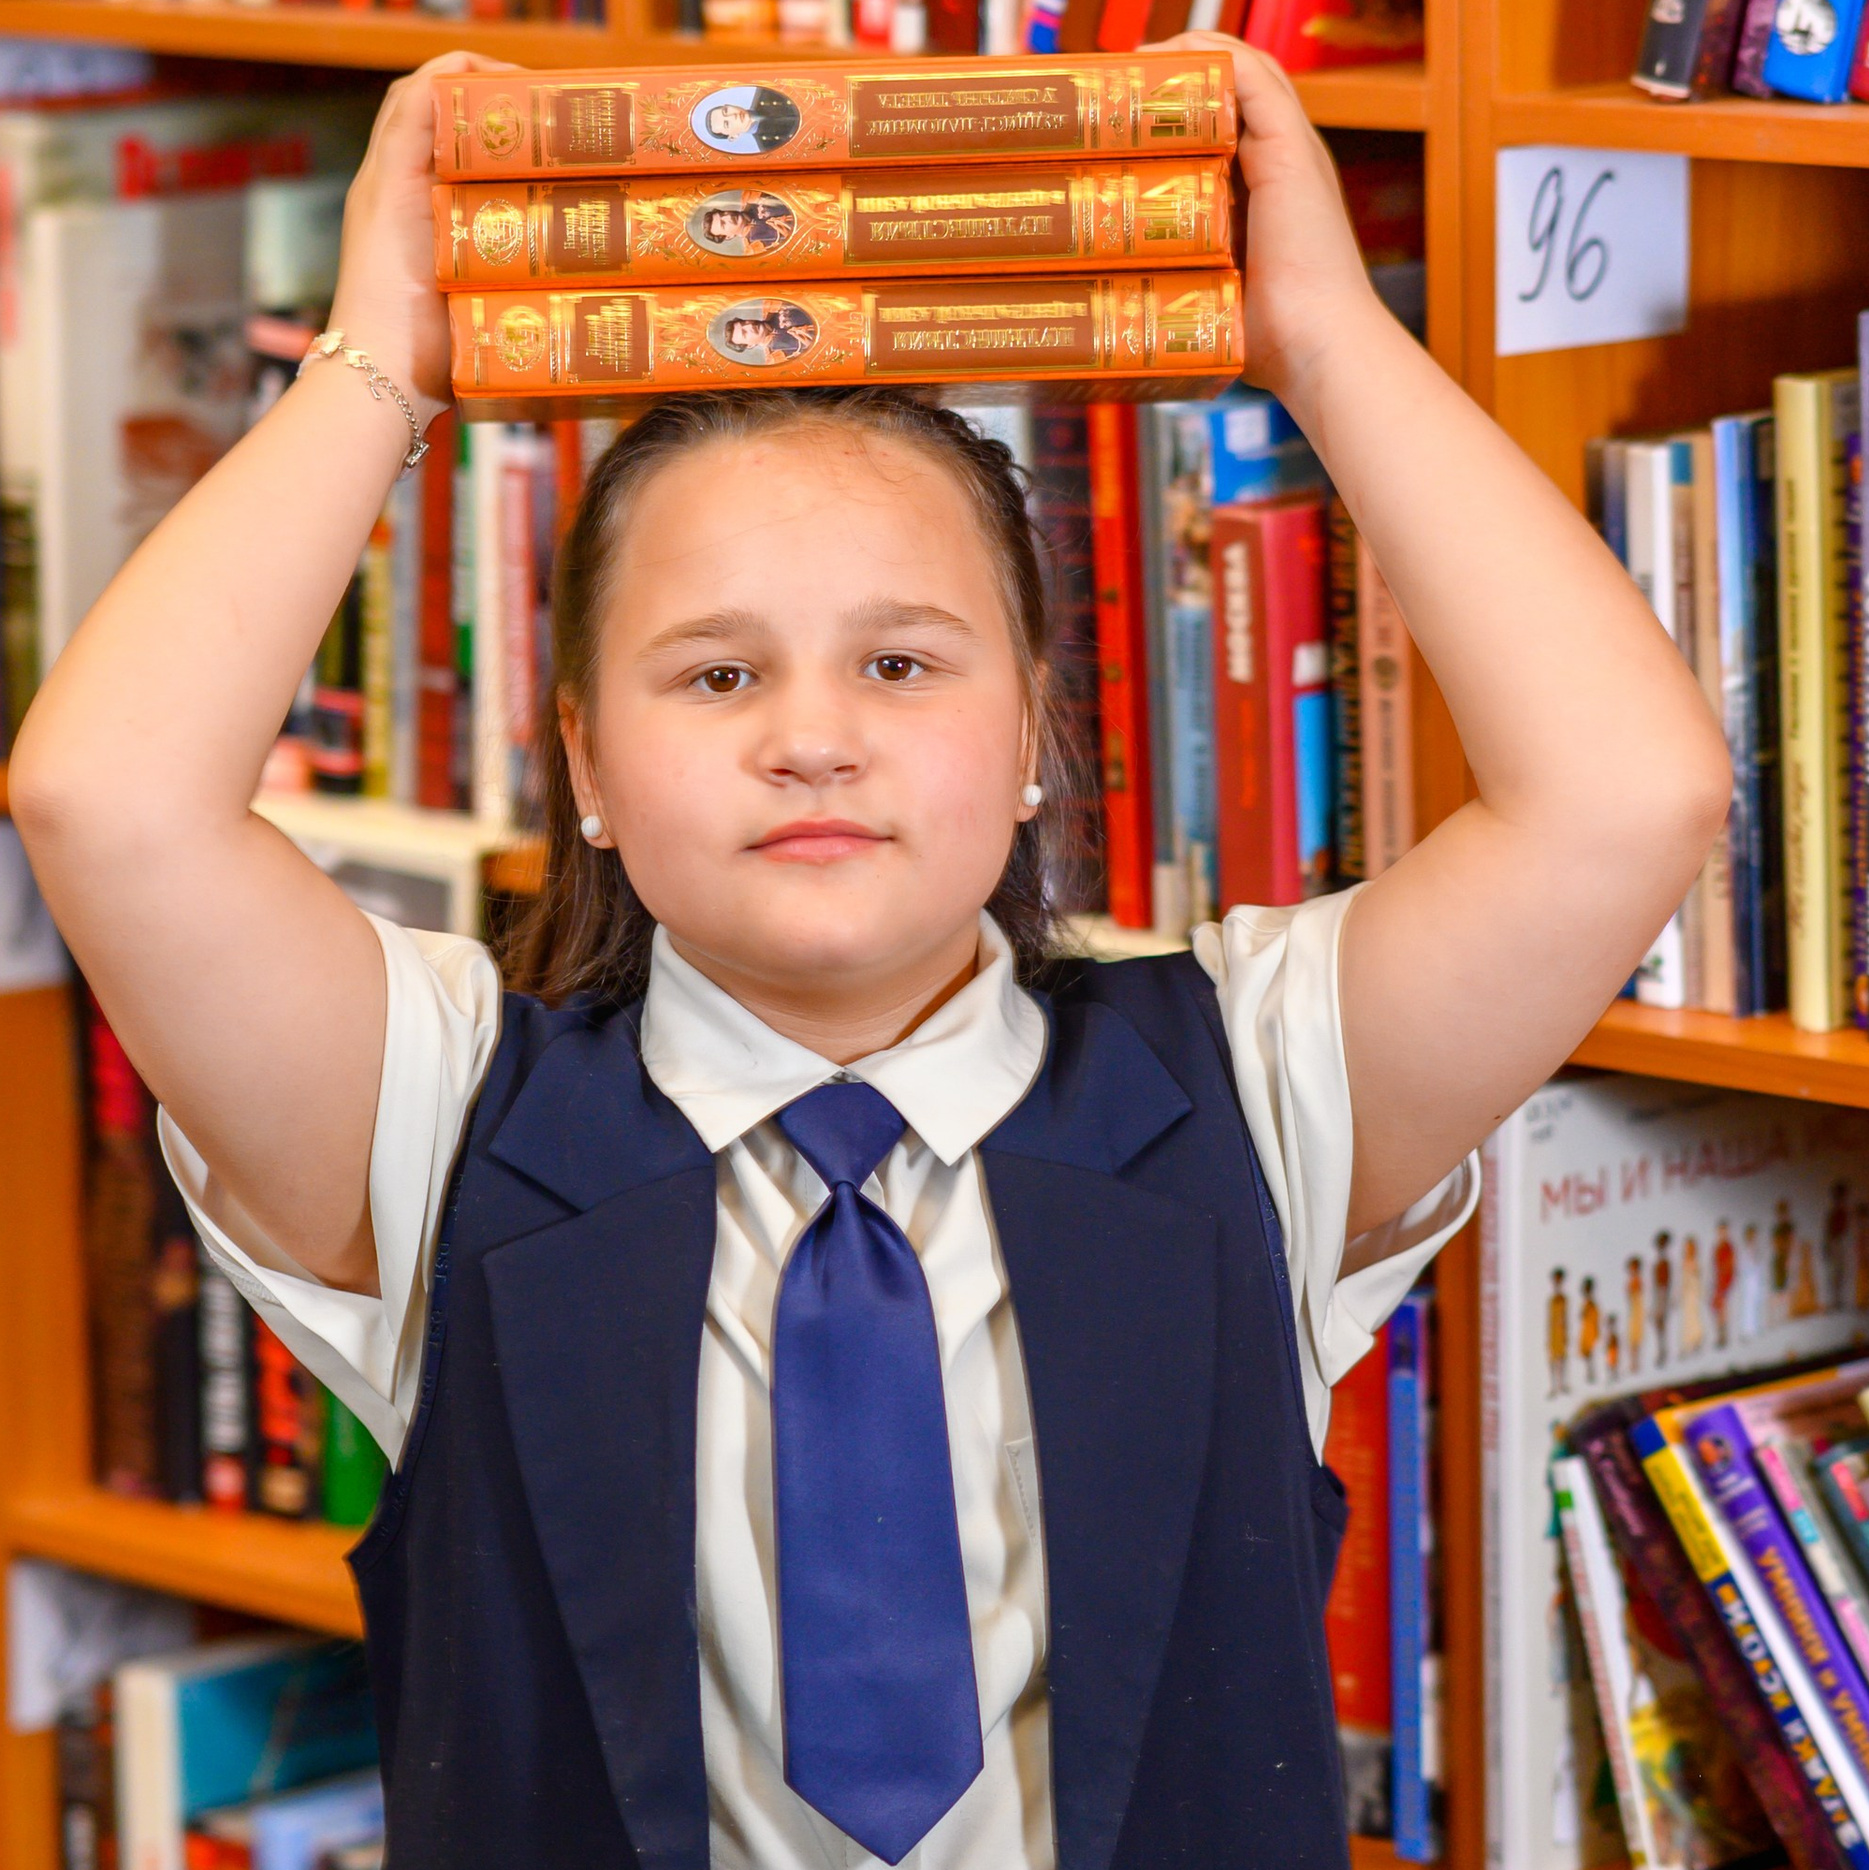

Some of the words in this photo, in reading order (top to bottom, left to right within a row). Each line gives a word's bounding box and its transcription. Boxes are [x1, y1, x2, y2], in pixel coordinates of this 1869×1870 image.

[869, 215, 1054, 243] ПУТЕШЕСТВИЯ
[1518, 166, 1615, 302] 96
[892, 326, 1077, 351] ПУТЕШЕСТВИЯ
[1539, 1163, 1609, 1226] МЫ
[1620, 1154, 1650, 1205] И
